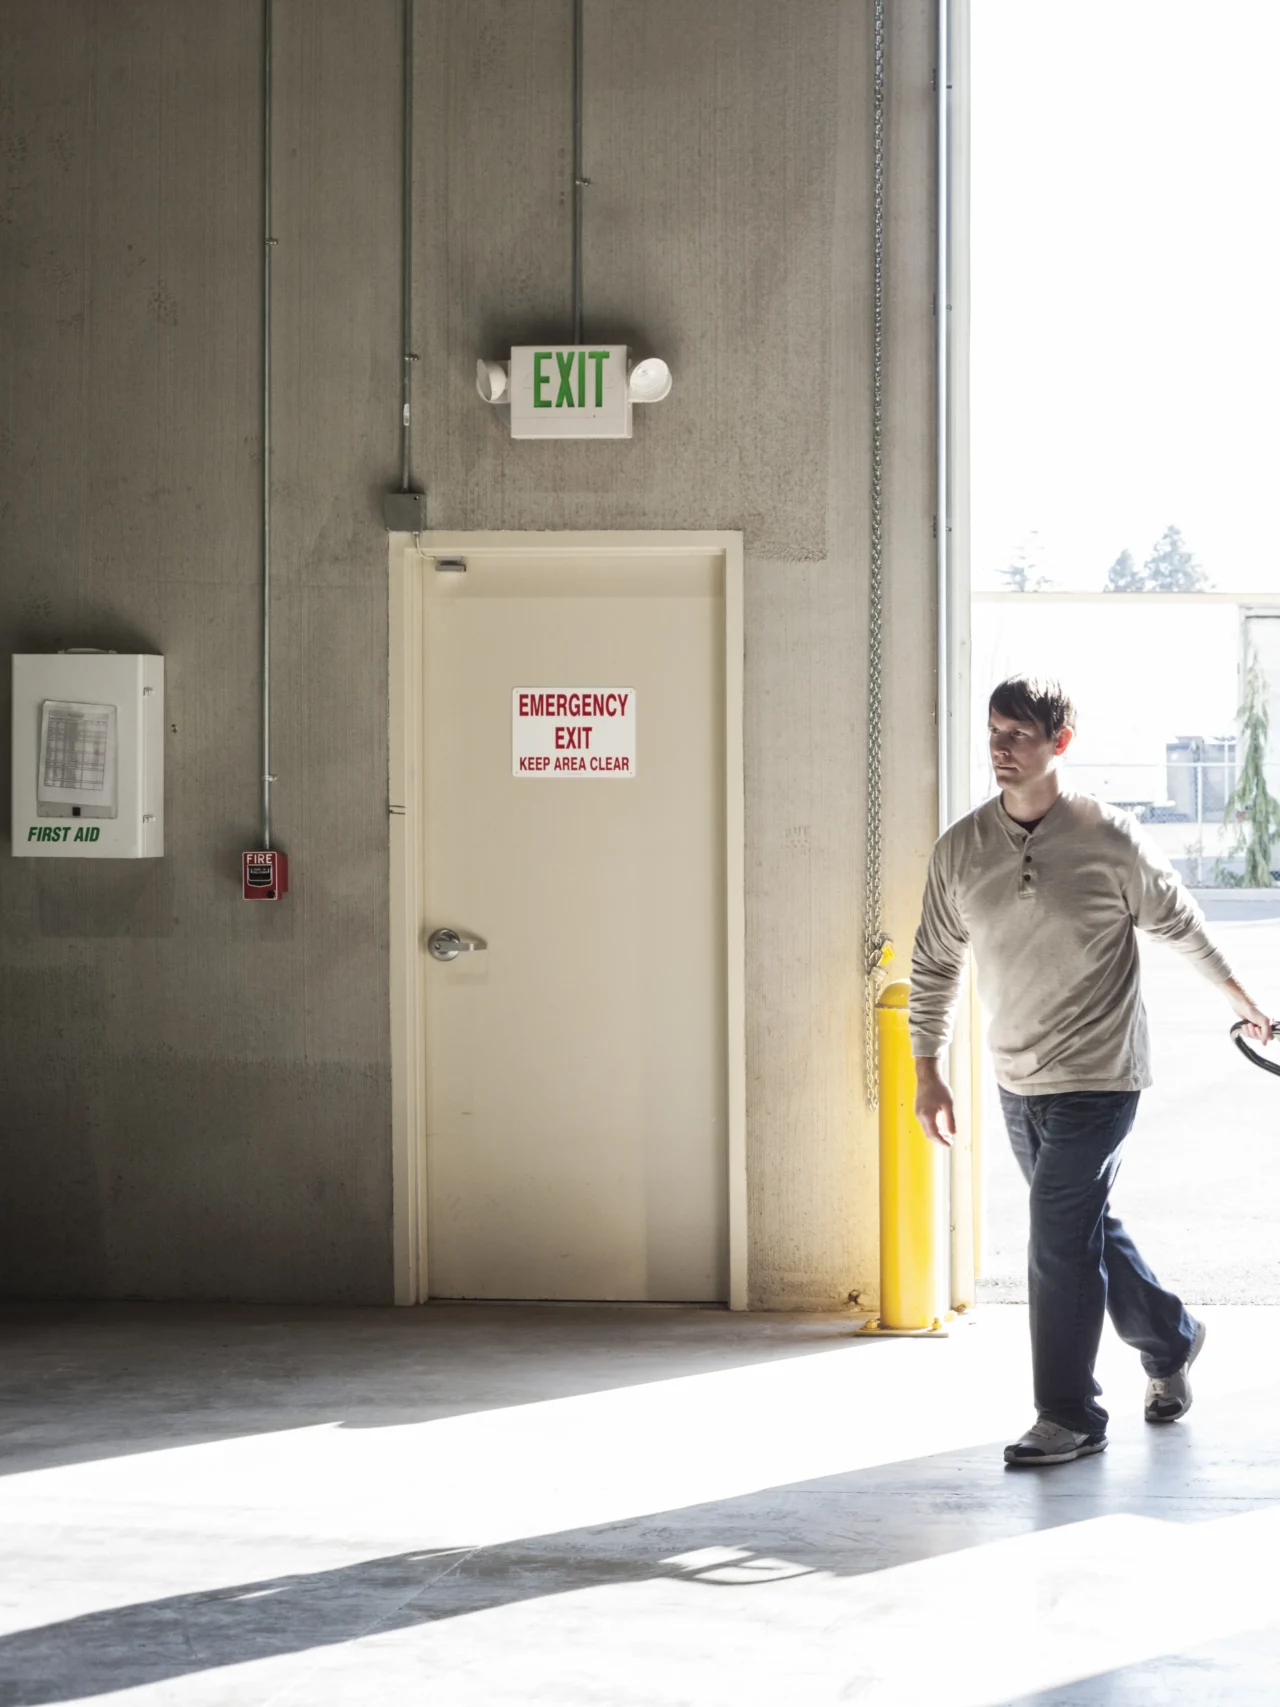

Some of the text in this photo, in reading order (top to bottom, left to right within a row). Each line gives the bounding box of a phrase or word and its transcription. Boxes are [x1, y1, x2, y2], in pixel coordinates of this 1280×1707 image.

[533, 351, 610, 408] EXIT
[519, 693, 629, 717] EMERGENCY
[555, 726, 593, 749] EXIT
[519, 756, 630, 771] KEEP AREA CLEAR
[27, 826, 101, 842] FIRST AID
[246, 853, 273, 865] FIRE
